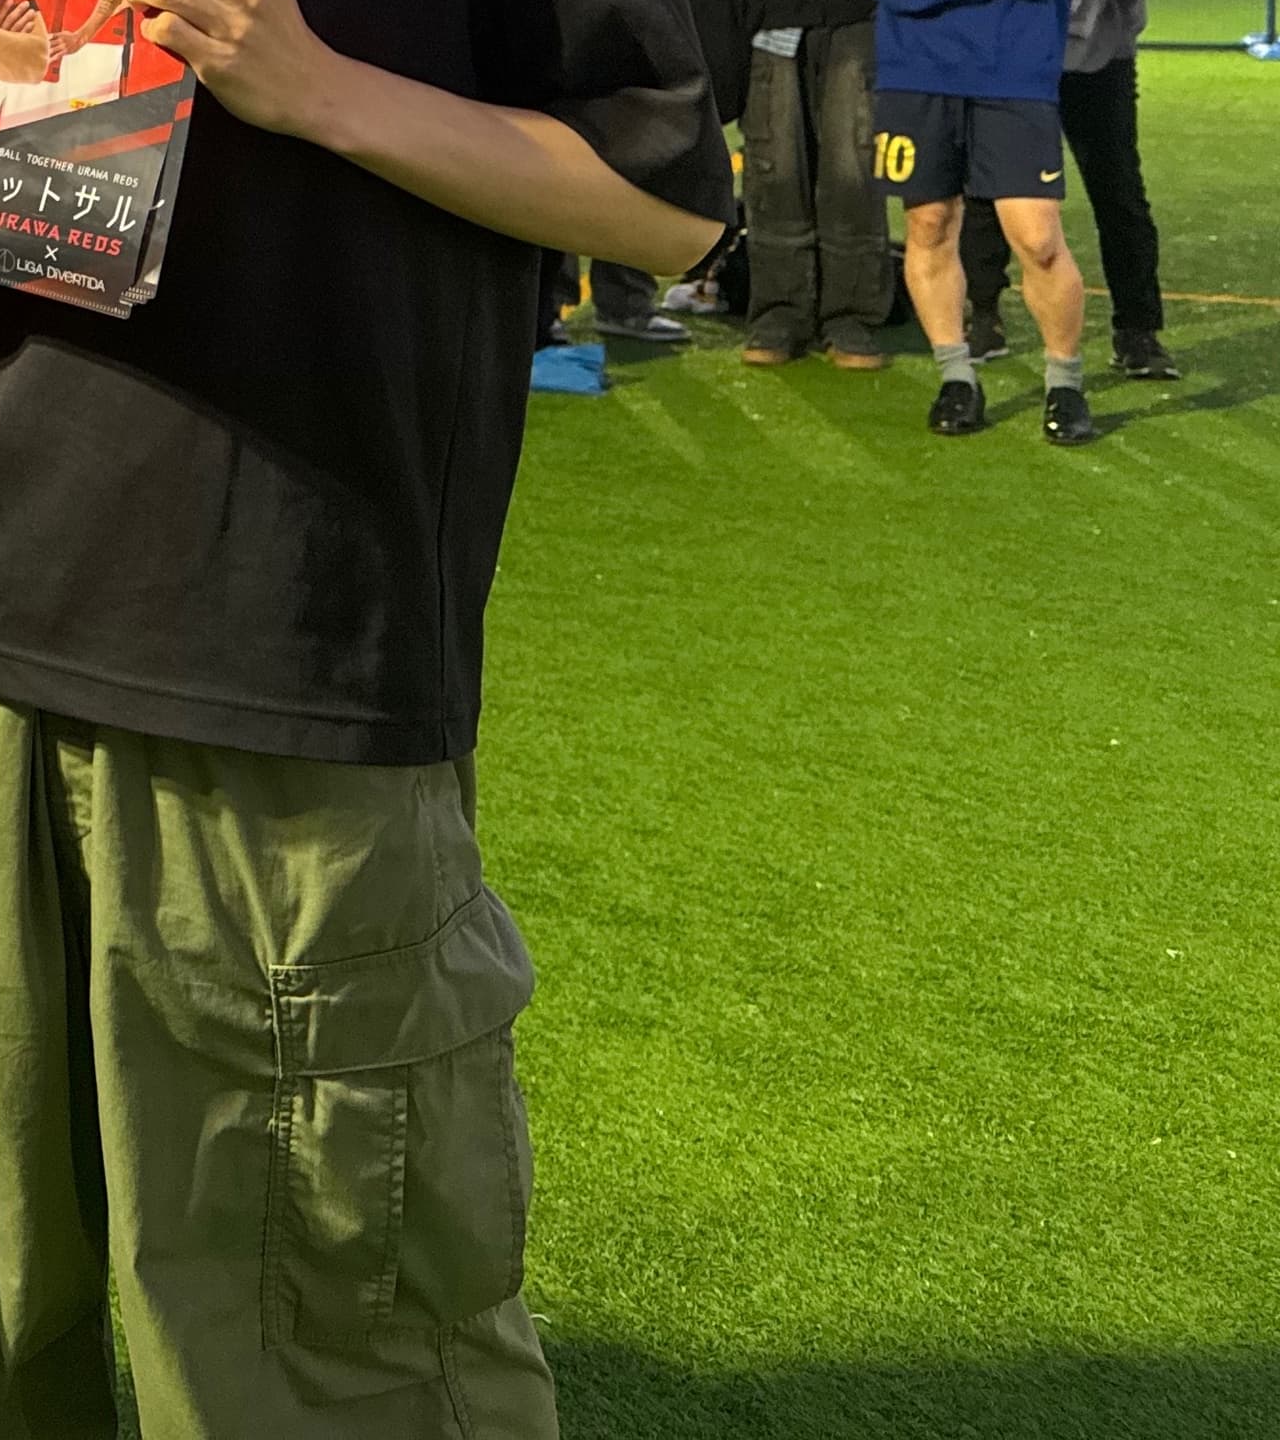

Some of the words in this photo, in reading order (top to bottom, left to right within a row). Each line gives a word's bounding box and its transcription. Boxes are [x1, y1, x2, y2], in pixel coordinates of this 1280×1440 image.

[26, 153, 73, 173] TOGETHER
[78, 164, 109, 181] URAWA
[113, 173, 139, 188] REDS
[873, 132, 916, 183] 10
[67, 228, 124, 257] REDS
